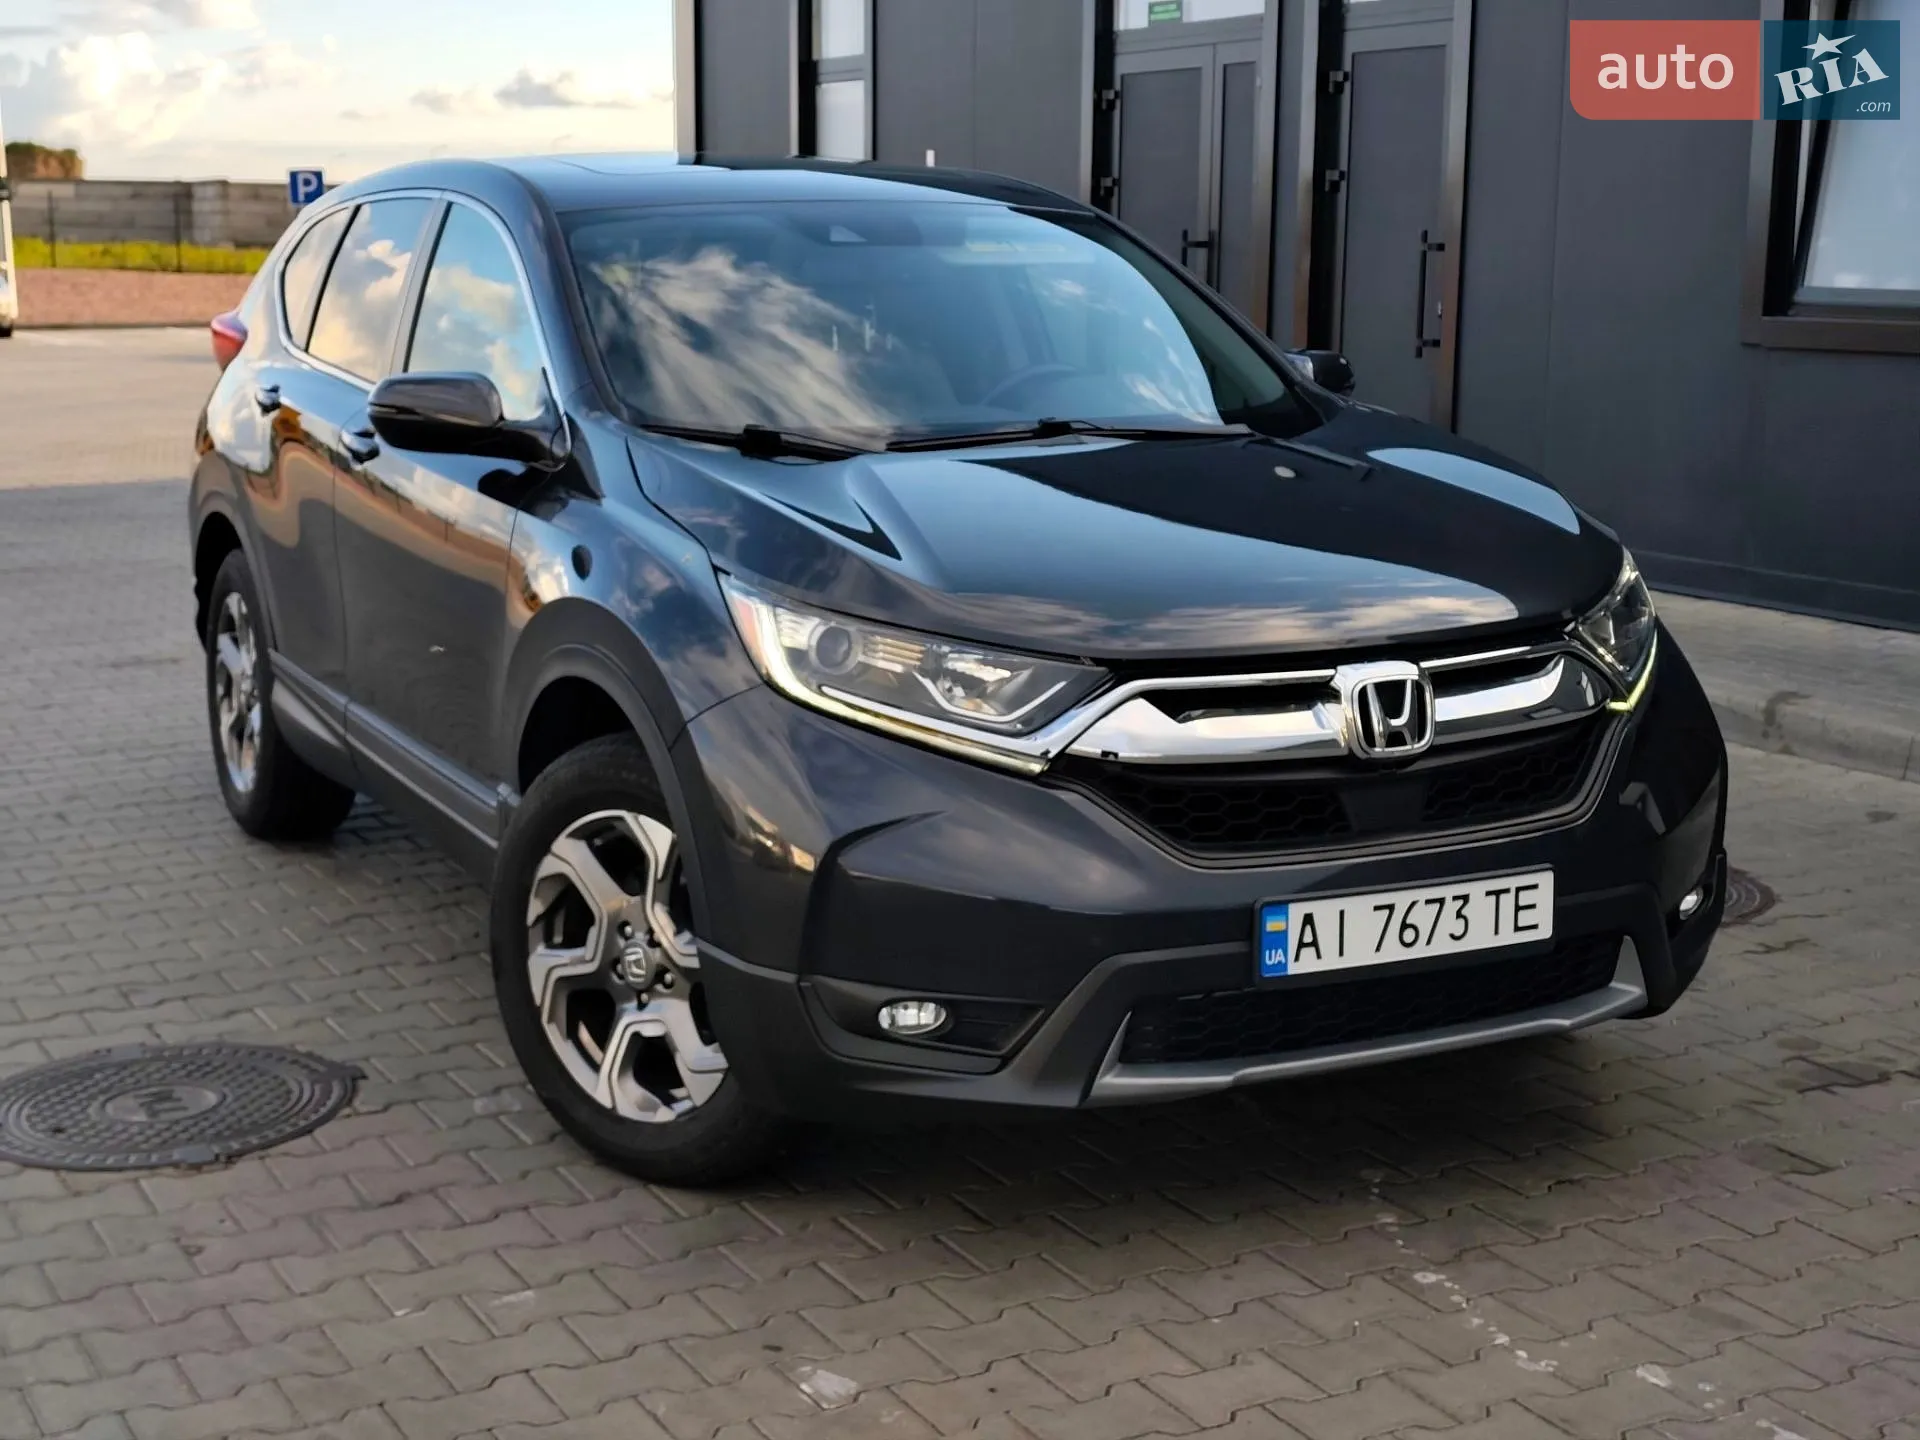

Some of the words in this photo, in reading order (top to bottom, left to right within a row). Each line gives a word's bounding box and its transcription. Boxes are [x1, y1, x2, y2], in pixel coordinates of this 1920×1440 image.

[297, 172, 318, 202] P
[1294, 909, 1345, 963] AI
[1373, 893, 1470, 953] 7673
[1485, 883, 1539, 936] TE
[1265, 948, 1286, 965] UA
